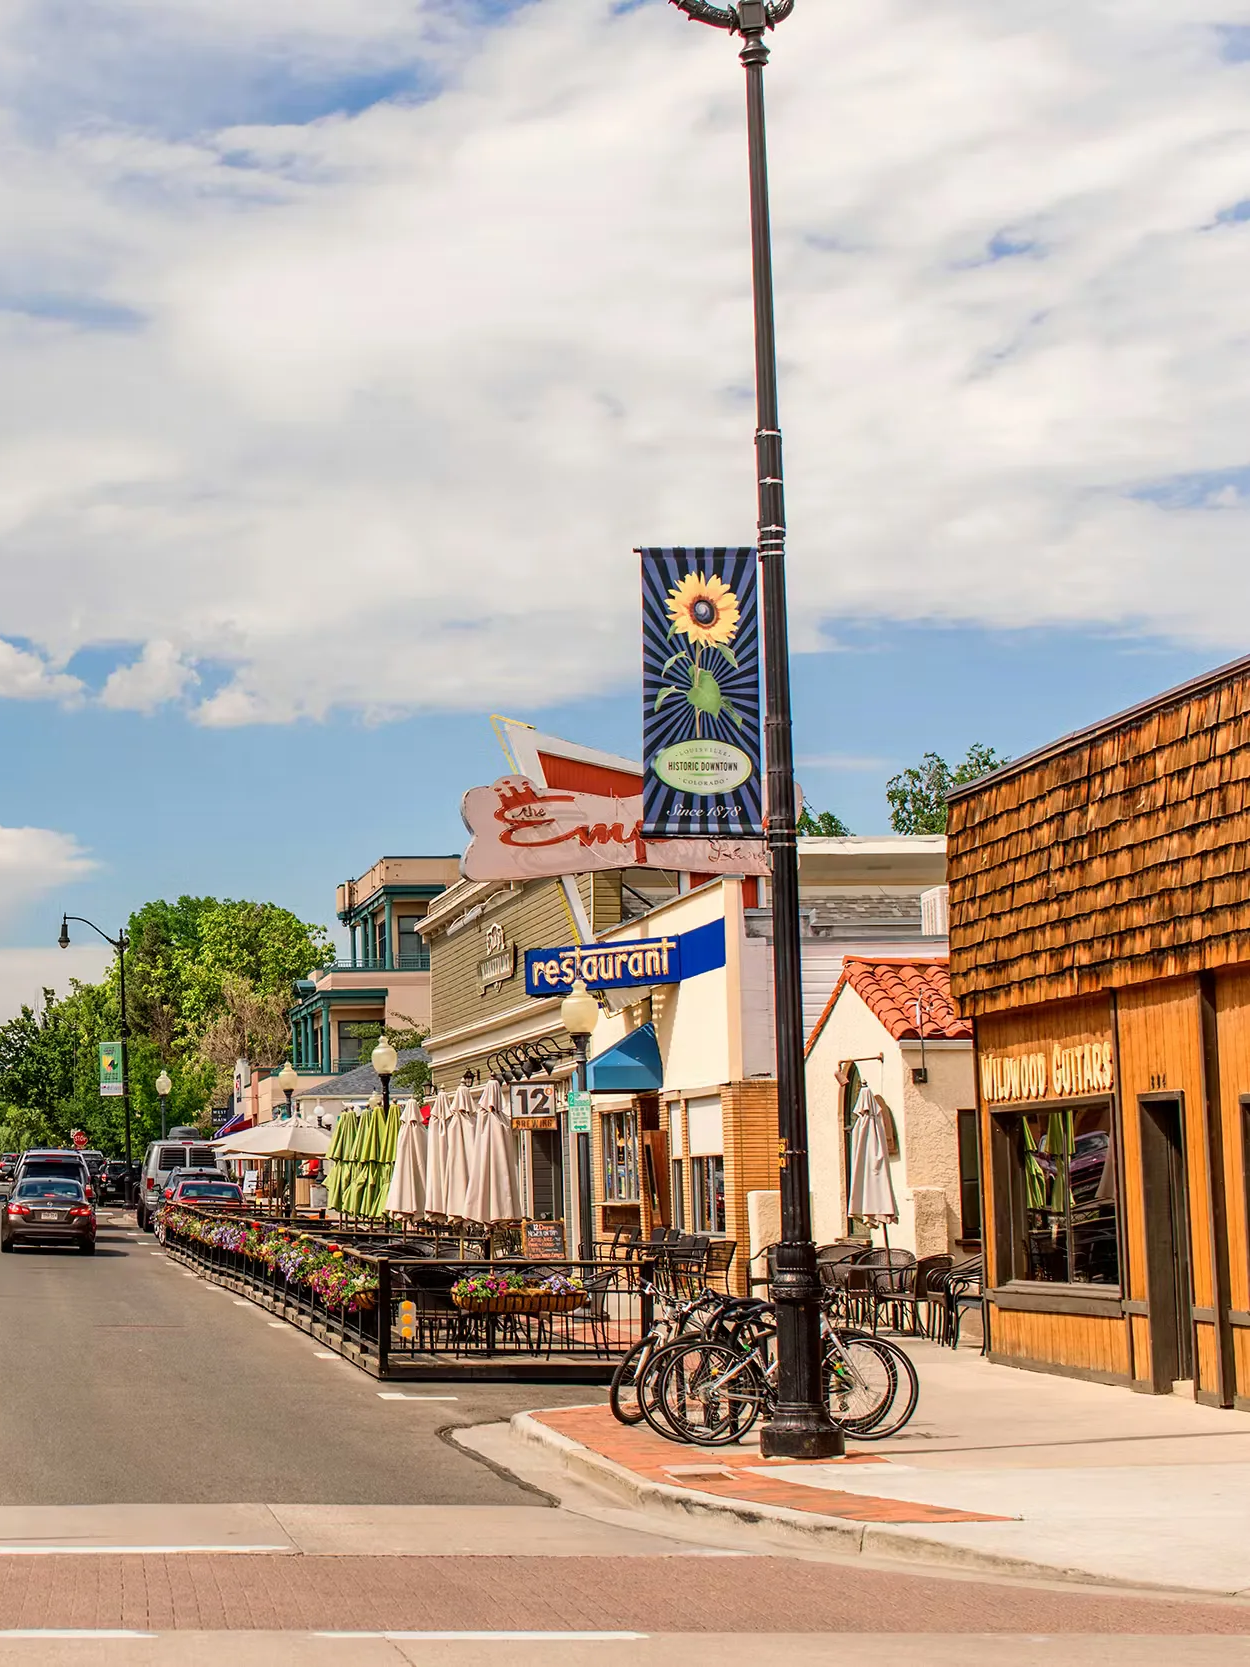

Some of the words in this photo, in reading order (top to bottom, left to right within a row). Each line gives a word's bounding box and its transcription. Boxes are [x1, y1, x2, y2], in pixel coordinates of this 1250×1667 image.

[680, 748, 727, 757] LOUISVILLE
[669, 762, 699, 771] HISTORIC
[701, 762, 738, 772] DOWNTOWN
[512, 805, 546, 818] the
[667, 804, 705, 817] Since
[707, 806, 742, 819] 1878
[532, 938, 676, 987] restaurant
[981, 1053, 1048, 1101] WILDWOOD
[1053, 1042, 1113, 1095] GUITARS
[516, 1120, 553, 1130] BREWING
